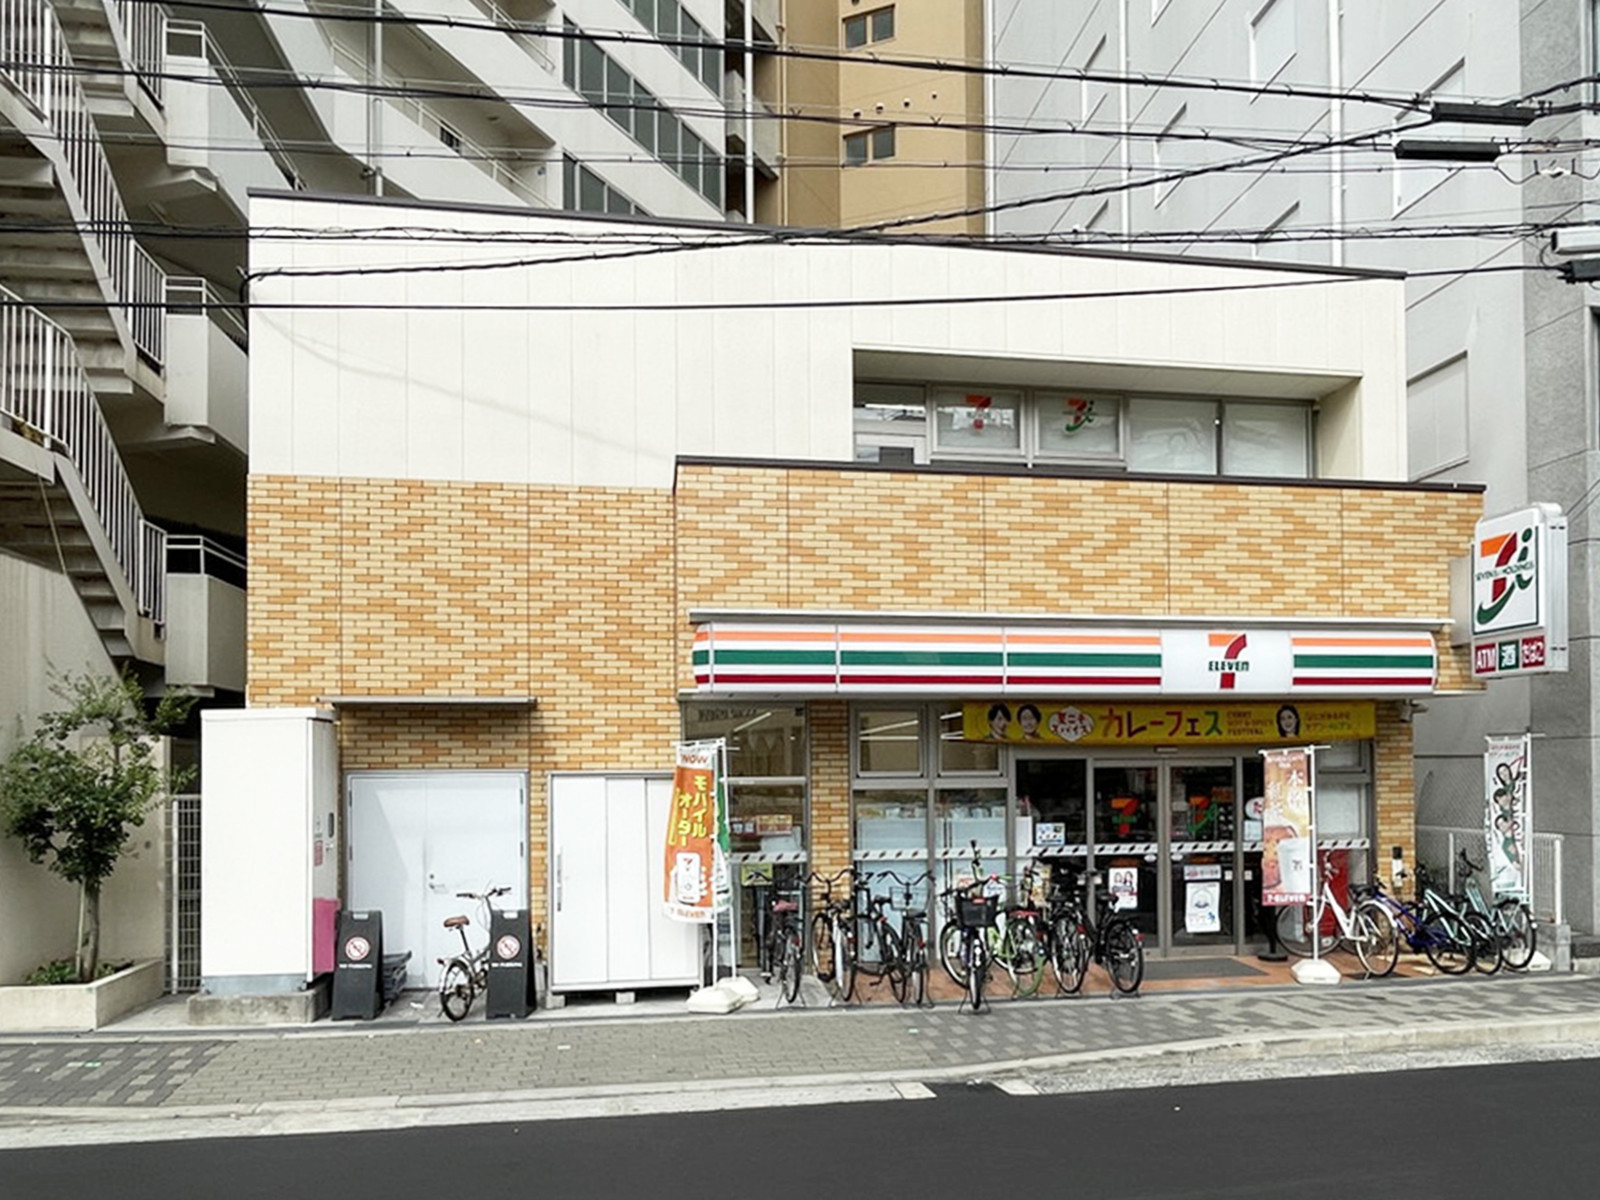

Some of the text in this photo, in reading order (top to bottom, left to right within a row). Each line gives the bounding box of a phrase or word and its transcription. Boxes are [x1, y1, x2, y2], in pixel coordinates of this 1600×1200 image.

[1476, 648, 1496, 669] ATM
[1501, 644, 1516, 667] 酒
[1099, 708, 1222, 738] カレーフェス
[693, 775, 709, 838] モバイル
